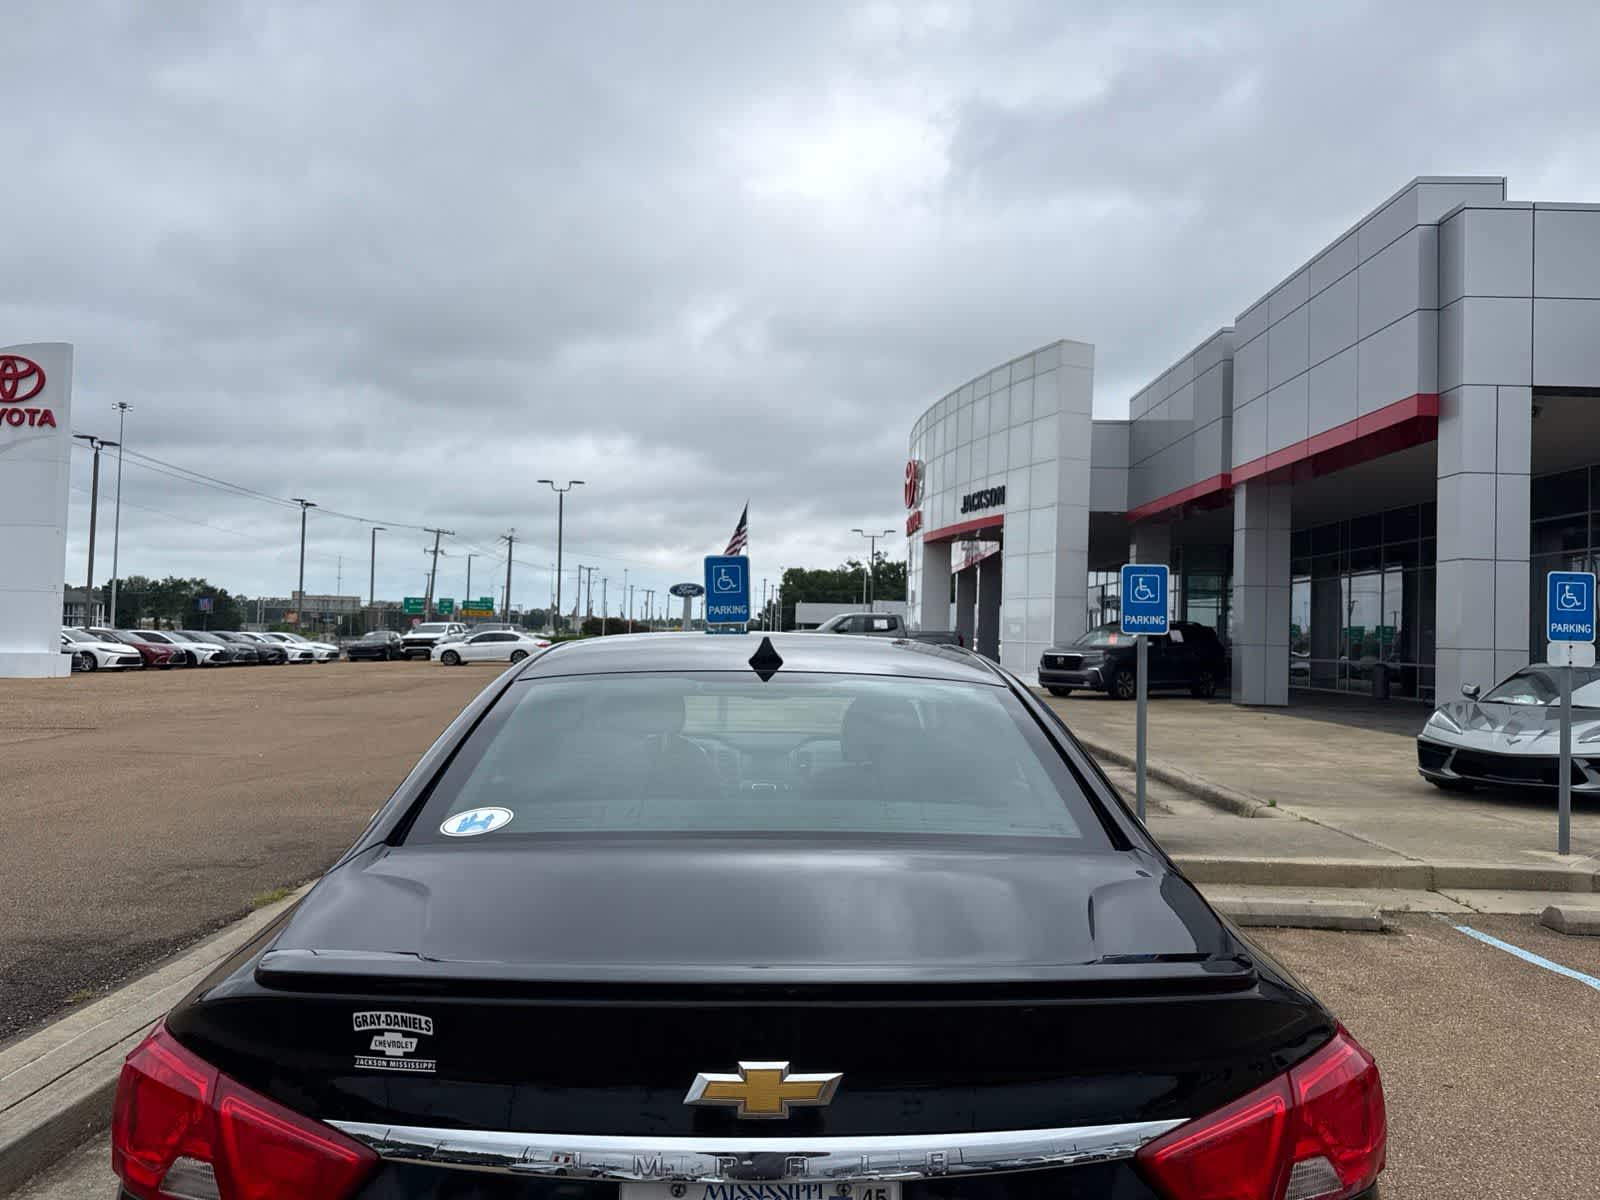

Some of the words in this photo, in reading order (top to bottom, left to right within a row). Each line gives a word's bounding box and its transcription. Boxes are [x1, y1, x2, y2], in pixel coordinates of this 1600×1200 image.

[961, 485, 1006, 514] JACKSON
[708, 604, 748, 615] PARKING
[1124, 615, 1166, 625] PARKING
[1550, 623, 1592, 633] PARKING
[374, 1039, 413, 1049] CHEVROLET
[355, 1057, 387, 1067] JACKSON
[389, 1060, 436, 1070] MISSISSIPPI
[572, 1151, 949, 1178] IMPALA
